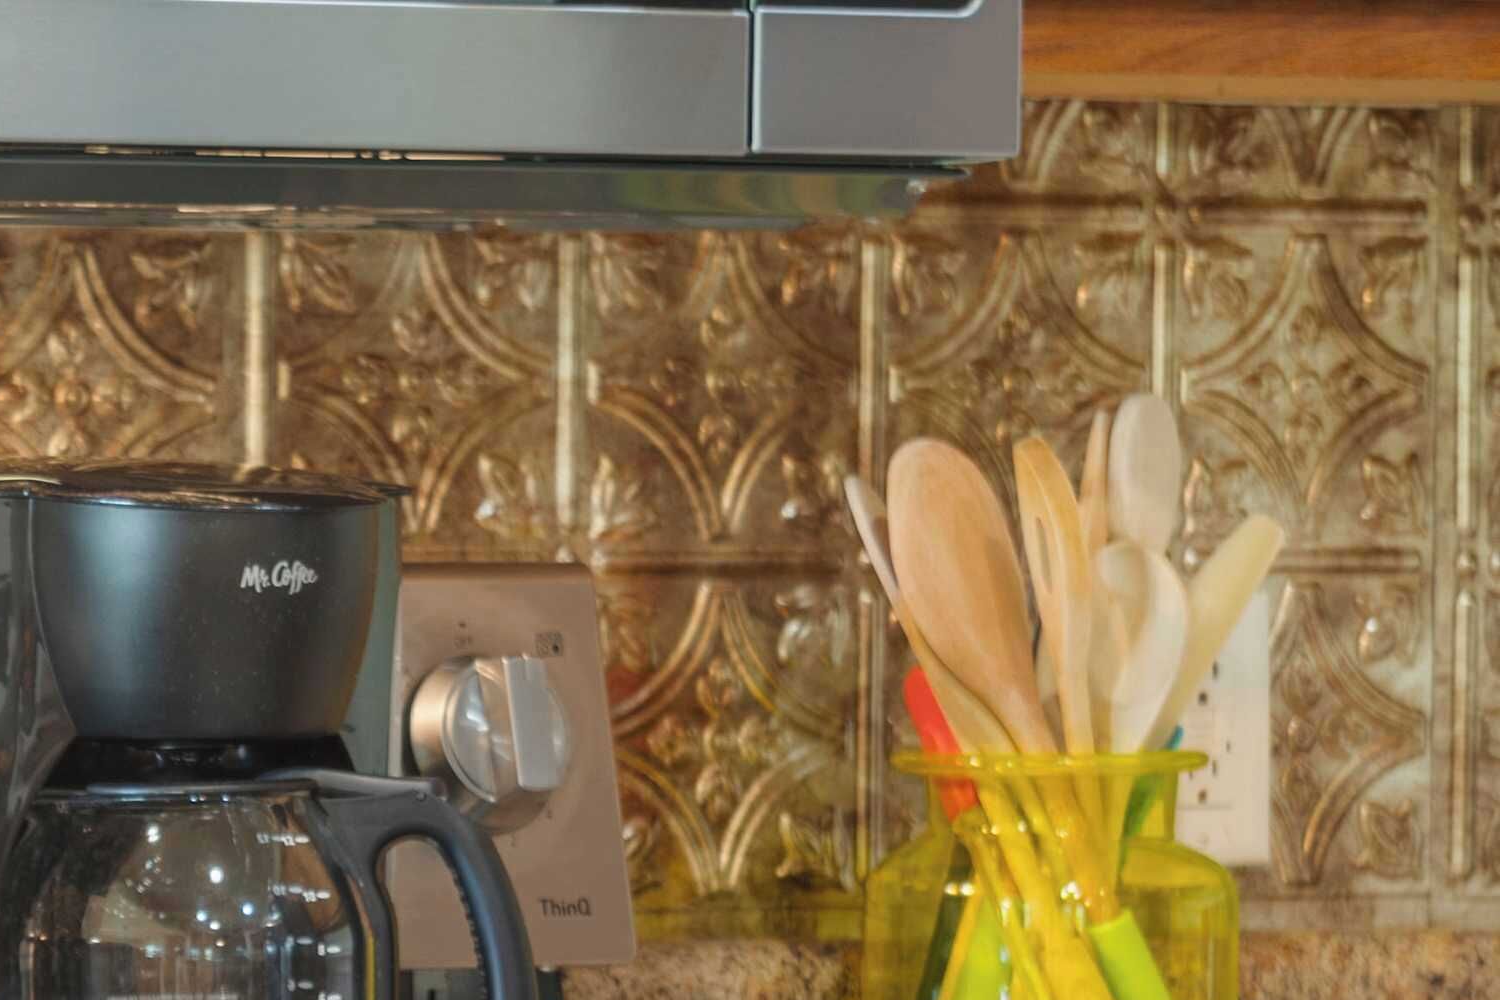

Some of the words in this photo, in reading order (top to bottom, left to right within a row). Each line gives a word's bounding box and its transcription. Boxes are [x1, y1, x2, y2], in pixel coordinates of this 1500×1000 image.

[240, 564, 271, 593] Mr.
[271, 560, 318, 595] Coffee
[538, 898, 592, 918] ThinQ
